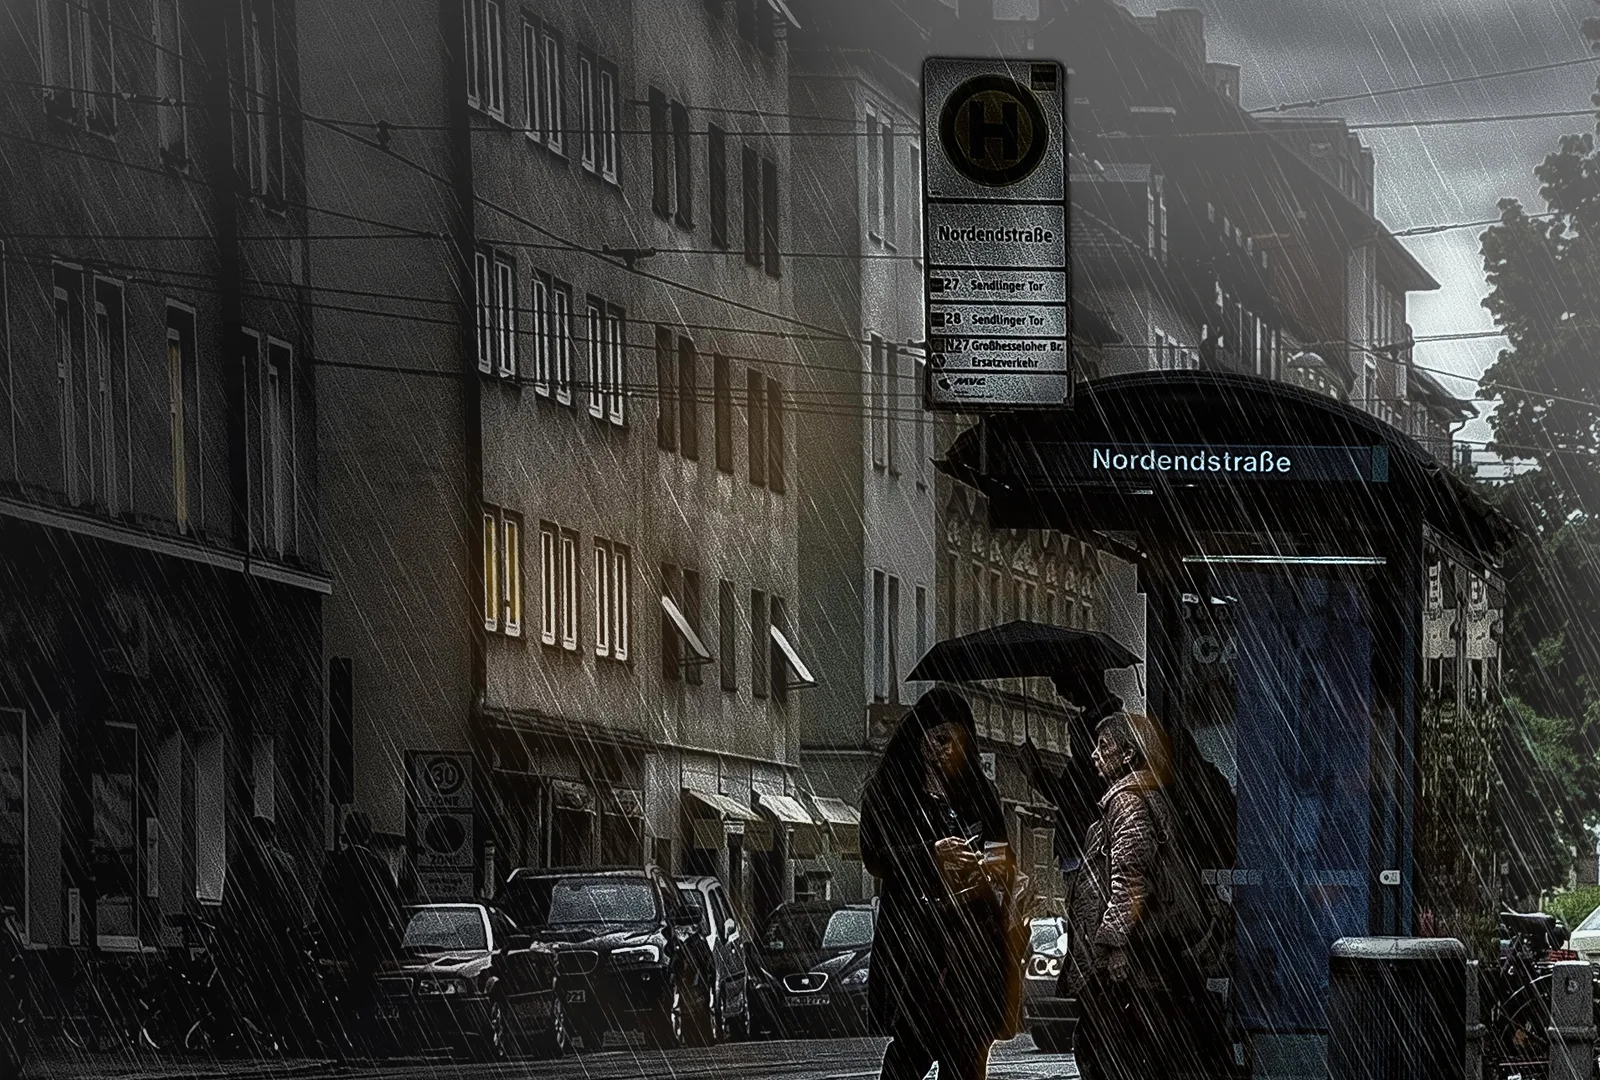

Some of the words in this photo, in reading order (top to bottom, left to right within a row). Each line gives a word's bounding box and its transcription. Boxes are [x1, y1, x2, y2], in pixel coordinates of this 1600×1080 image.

[968, 100, 1018, 160] H
[939, 225, 1053, 243] Nordendstraße
[944, 278, 960, 290] 27
[971, 280, 1026, 293] Sendlinger
[1028, 281, 1044, 291] Tor
[945, 312, 961, 325] 28
[971, 314, 1026, 327] Sendlinger
[1029, 315, 1045, 326] Tor
[971, 341, 1047, 352] Großhesseloher
[1050, 341, 1064, 352] Br.
[971, 357, 1039, 368] Ersatzverkehr
[954, 378, 986, 386] MVG
[1092, 447, 1292, 474] Nordendstraße
